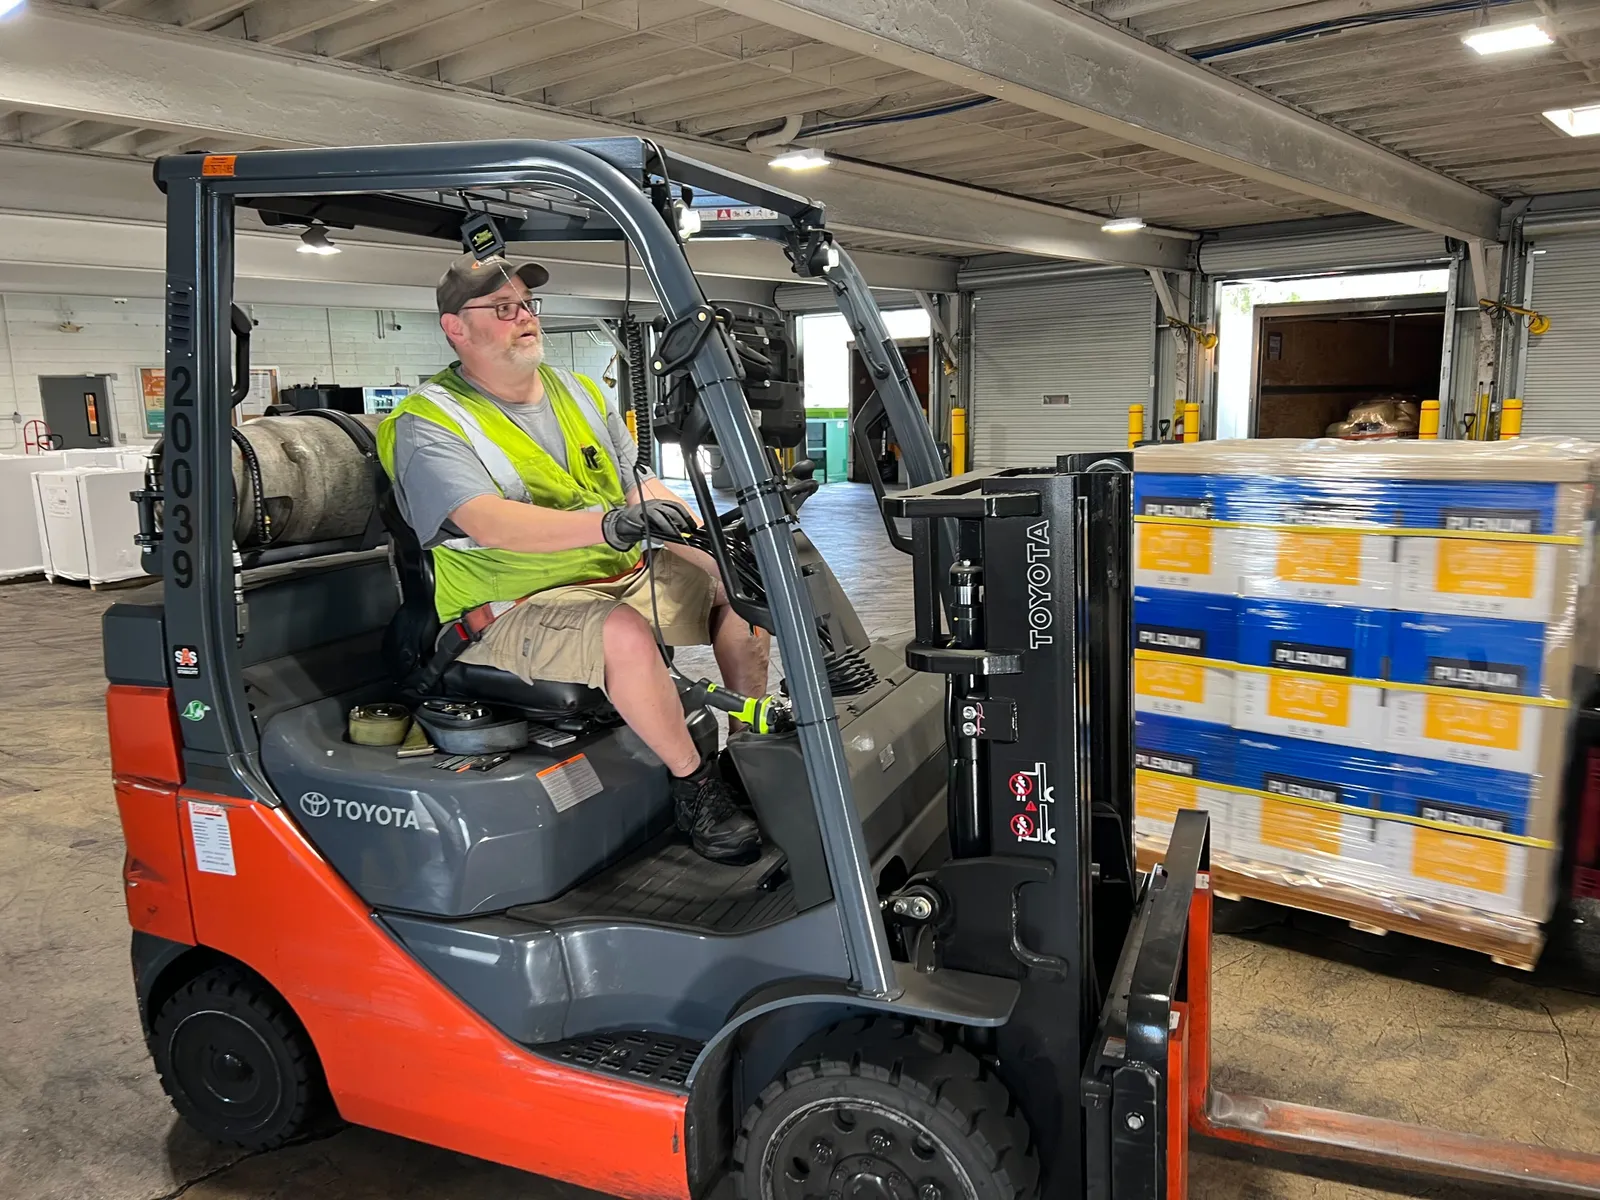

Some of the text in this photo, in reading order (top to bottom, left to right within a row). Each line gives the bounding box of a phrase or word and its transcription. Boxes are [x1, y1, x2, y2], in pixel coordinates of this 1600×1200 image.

[1027, 520, 1052, 649] TOYOTA
[1139, 631, 1201, 650] PLENUM
[1276, 649, 1346, 669] PLENUM
[1435, 667, 1518, 688] PLENUM
[1135, 753, 1193, 776] PLENUM
[1268, 781, 1337, 803] PLENUM
[333, 798, 420, 830] TOYOTA
